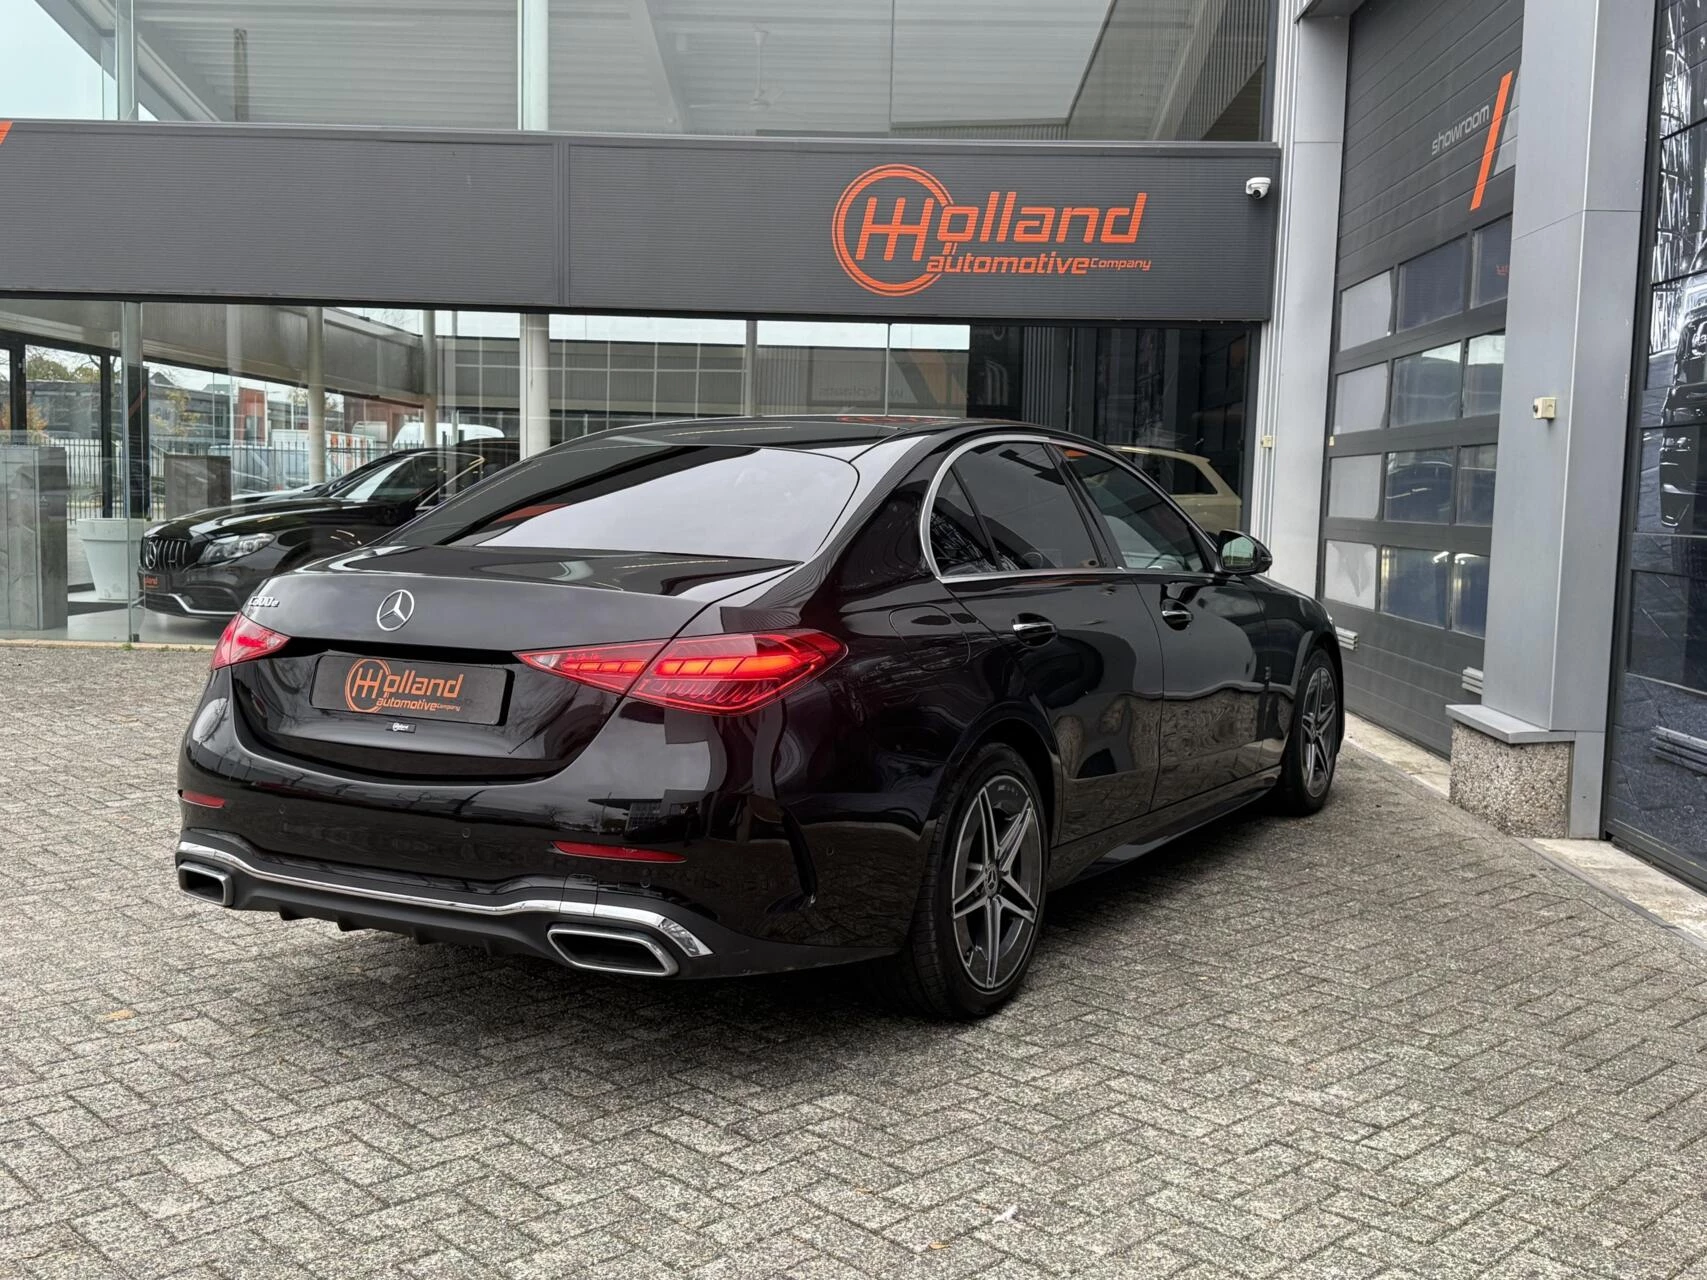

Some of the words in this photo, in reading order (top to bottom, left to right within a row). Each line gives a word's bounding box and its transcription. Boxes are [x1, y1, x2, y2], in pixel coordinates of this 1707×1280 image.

[1431, 104, 1490, 156] showroom
[855, 191, 1148, 261] Holland
[926, 251, 1089, 274] automotive
[352, 668, 464, 699] Holland
[376, 697, 438, 712] automotive
